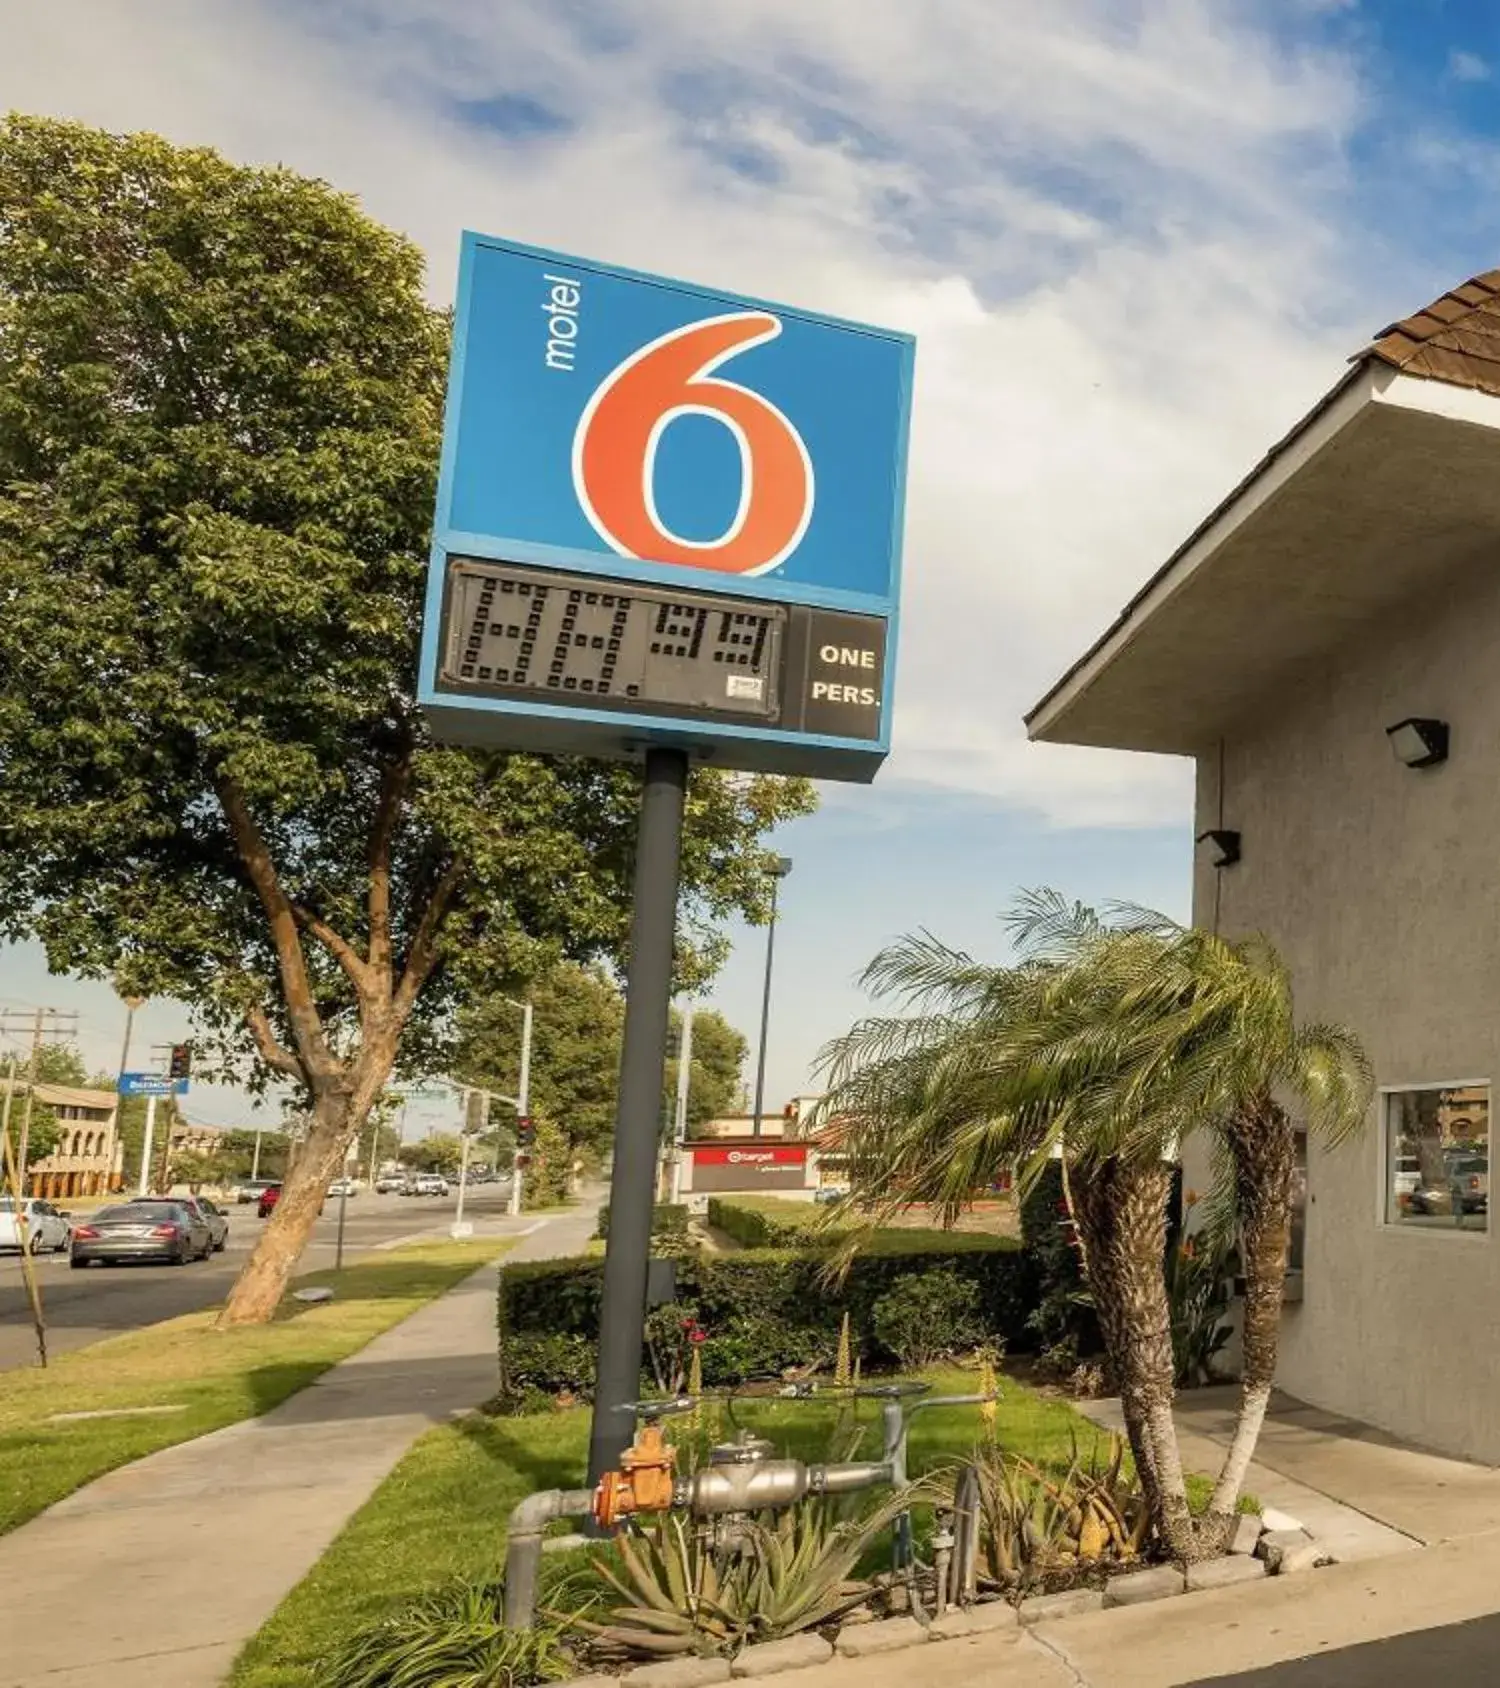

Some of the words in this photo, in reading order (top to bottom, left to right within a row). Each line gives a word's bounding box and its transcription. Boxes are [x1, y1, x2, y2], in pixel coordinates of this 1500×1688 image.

[541, 273, 581, 371] motel
[572, 311, 815, 576] 6
[819, 645, 875, 669] ONE
[811, 681, 881, 707] PERS.
